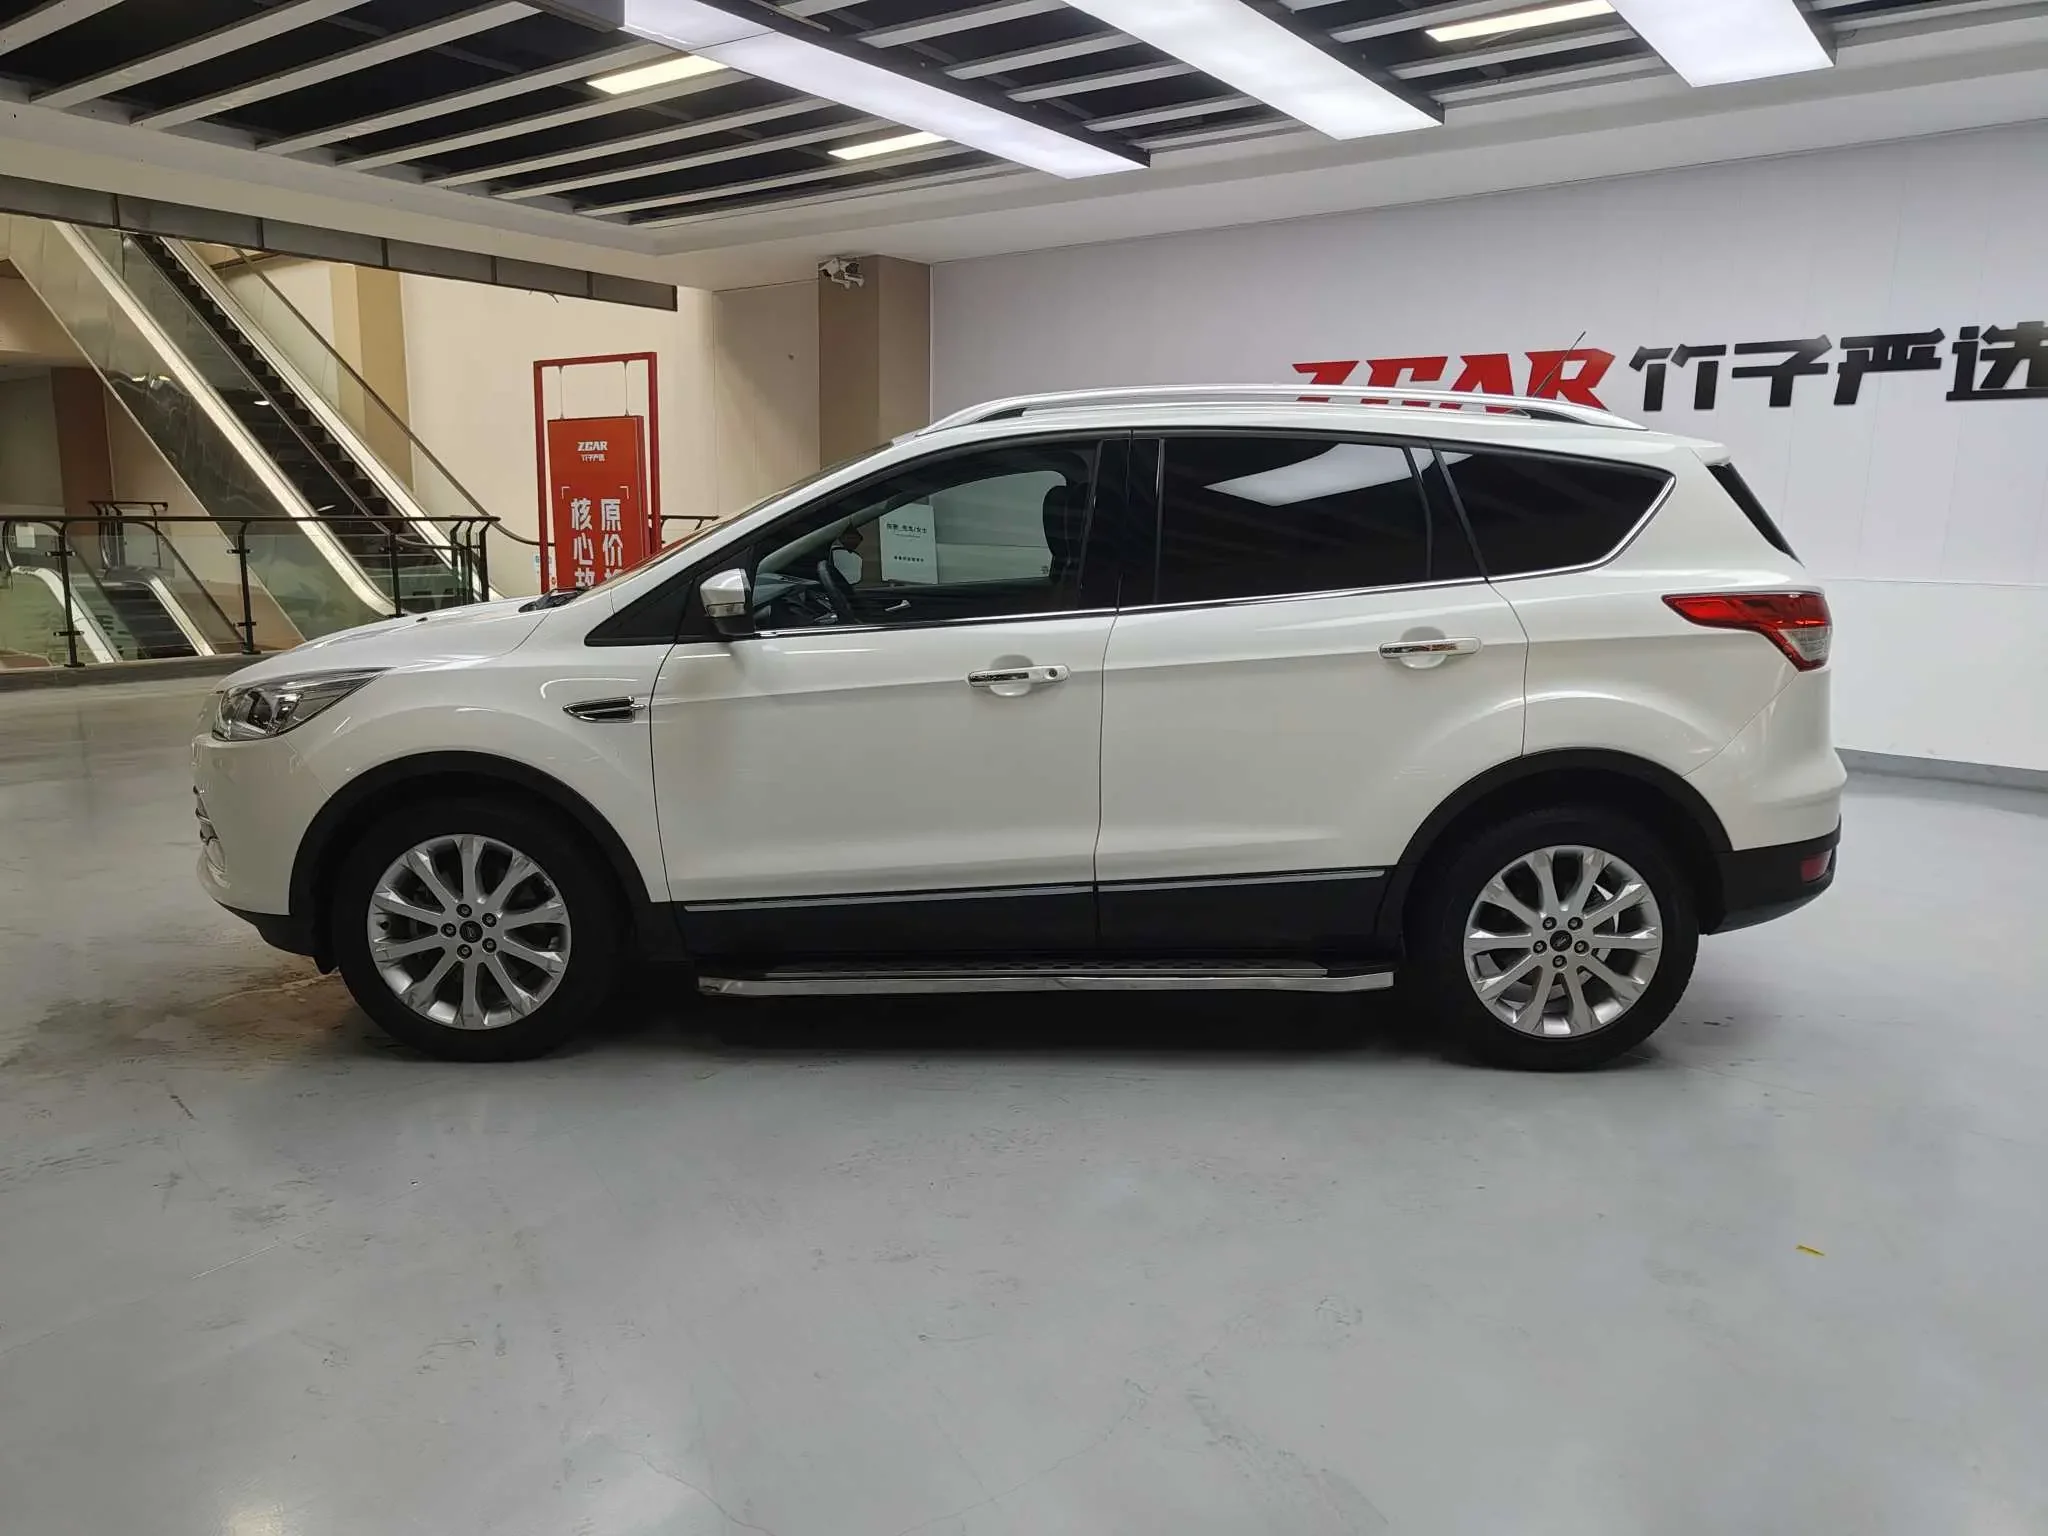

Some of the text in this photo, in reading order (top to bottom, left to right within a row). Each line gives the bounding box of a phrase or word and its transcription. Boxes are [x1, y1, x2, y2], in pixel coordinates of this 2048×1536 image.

[1629, 320, 2048, 411] 竹子严选
[577, 441, 608, 451] ZCAR
